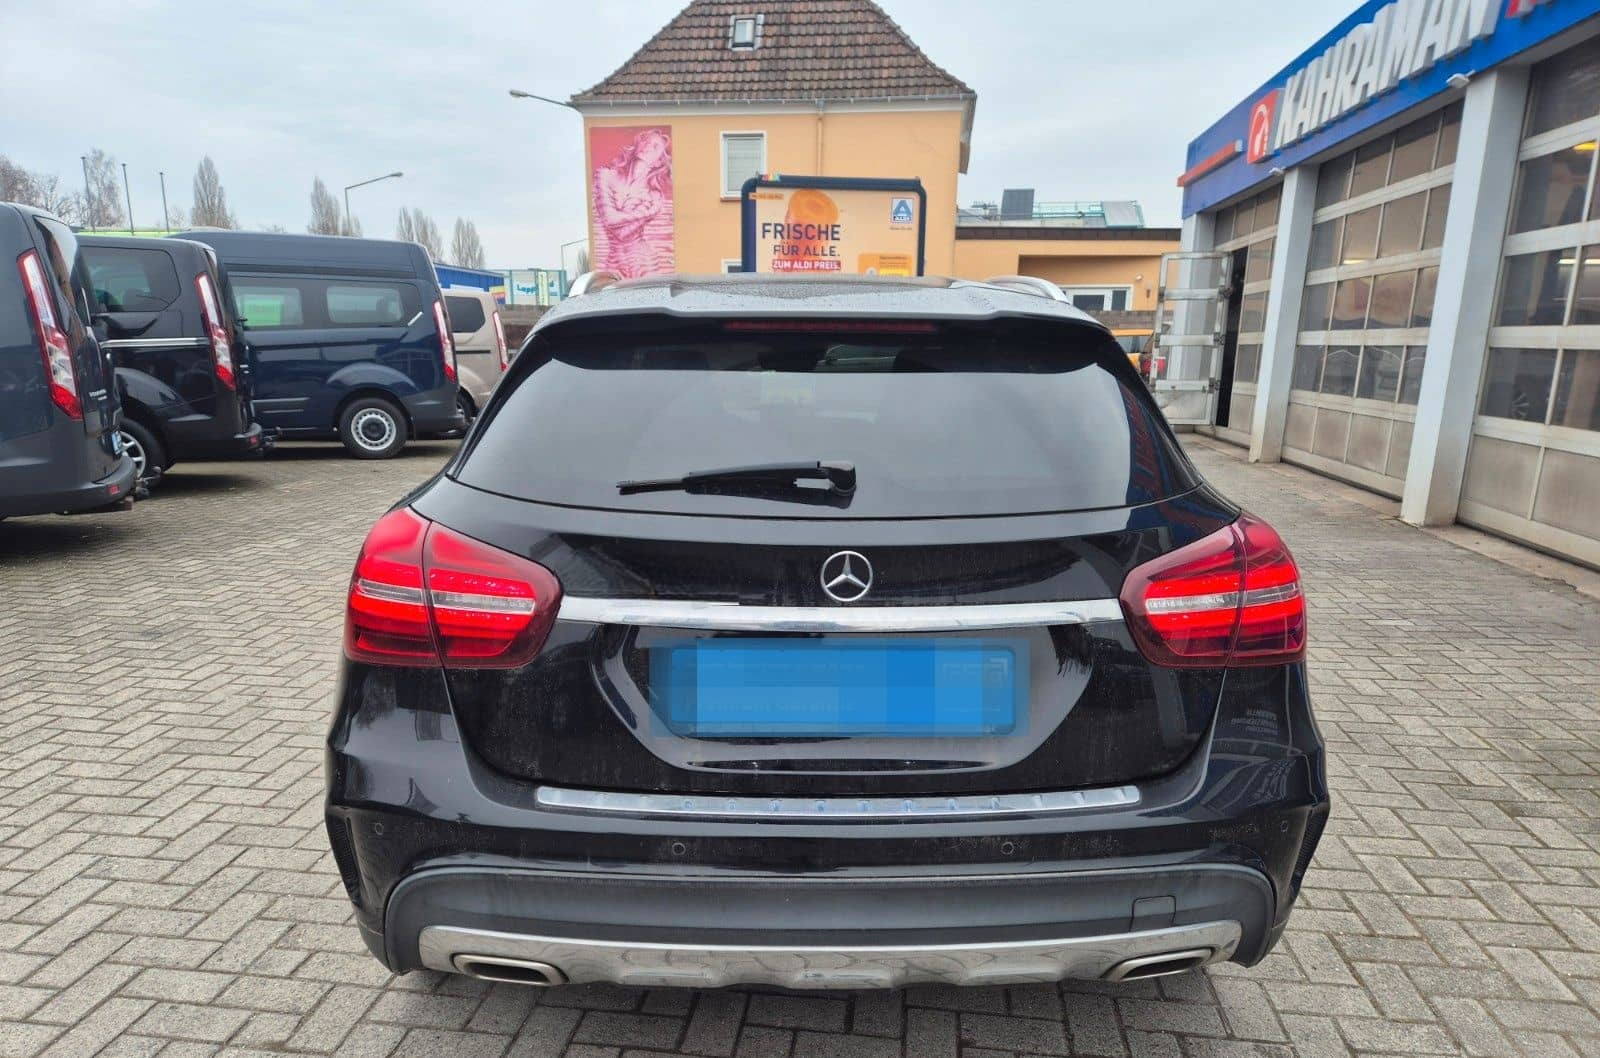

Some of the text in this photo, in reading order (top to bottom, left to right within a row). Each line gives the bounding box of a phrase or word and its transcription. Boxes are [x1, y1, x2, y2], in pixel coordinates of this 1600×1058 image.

[1274, 0, 1499, 149] KAHRAMAN
[762, 223, 841, 241] FRISCHE
[773, 241, 841, 257] FÜR ALLE.
[773, 260, 791, 269] ZUM
[793, 260, 813, 269] ALDI
